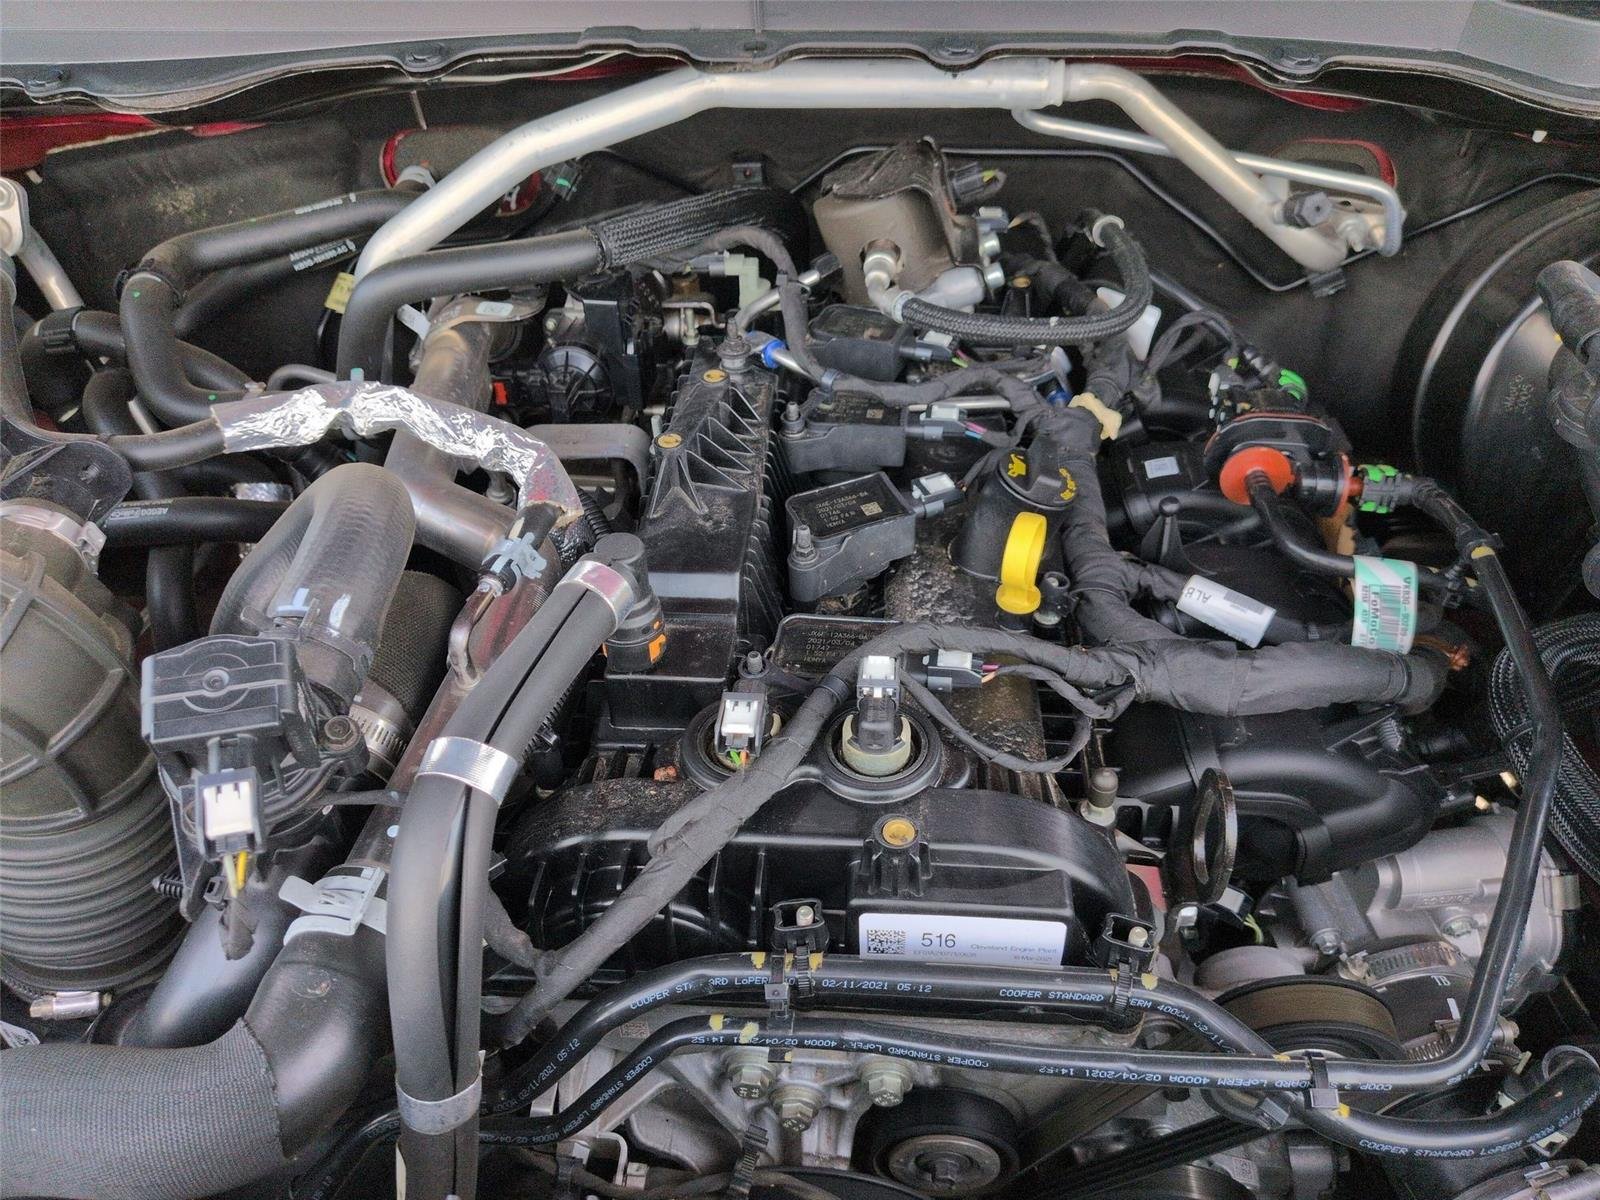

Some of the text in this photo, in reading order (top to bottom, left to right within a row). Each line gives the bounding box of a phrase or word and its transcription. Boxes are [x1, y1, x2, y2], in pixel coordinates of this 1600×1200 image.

[921, 932, 956, 948] 516
[822, 979, 888, 990] 02/11/2021
[897, 983, 932, 993] 05:12
[630, 988, 670, 1010] COOPER
[999, 988, 1041, 999] COOPER
[1049, 991, 1104, 1002] STANDARD
[691, 1036, 724, 1044] 14:52
[804, 1039, 838, 1047] 4000A
[556, 1038, 581, 1062] 05:12
[888, 1047, 942, 1062] STANDARD
[625, 1055, 653, 1081] COOPER
[1085, 1069, 1162, 1082] 02/04/2021
[1168, 1075, 1211, 1085] 4000A
[1217, 1078, 1268, 1088] LoPERM
[590, 1080, 624, 1111] STANDARD
[1359, 1139, 1409, 1156] COOPER
[1413, 1148, 1475, 1158] STANDARD
